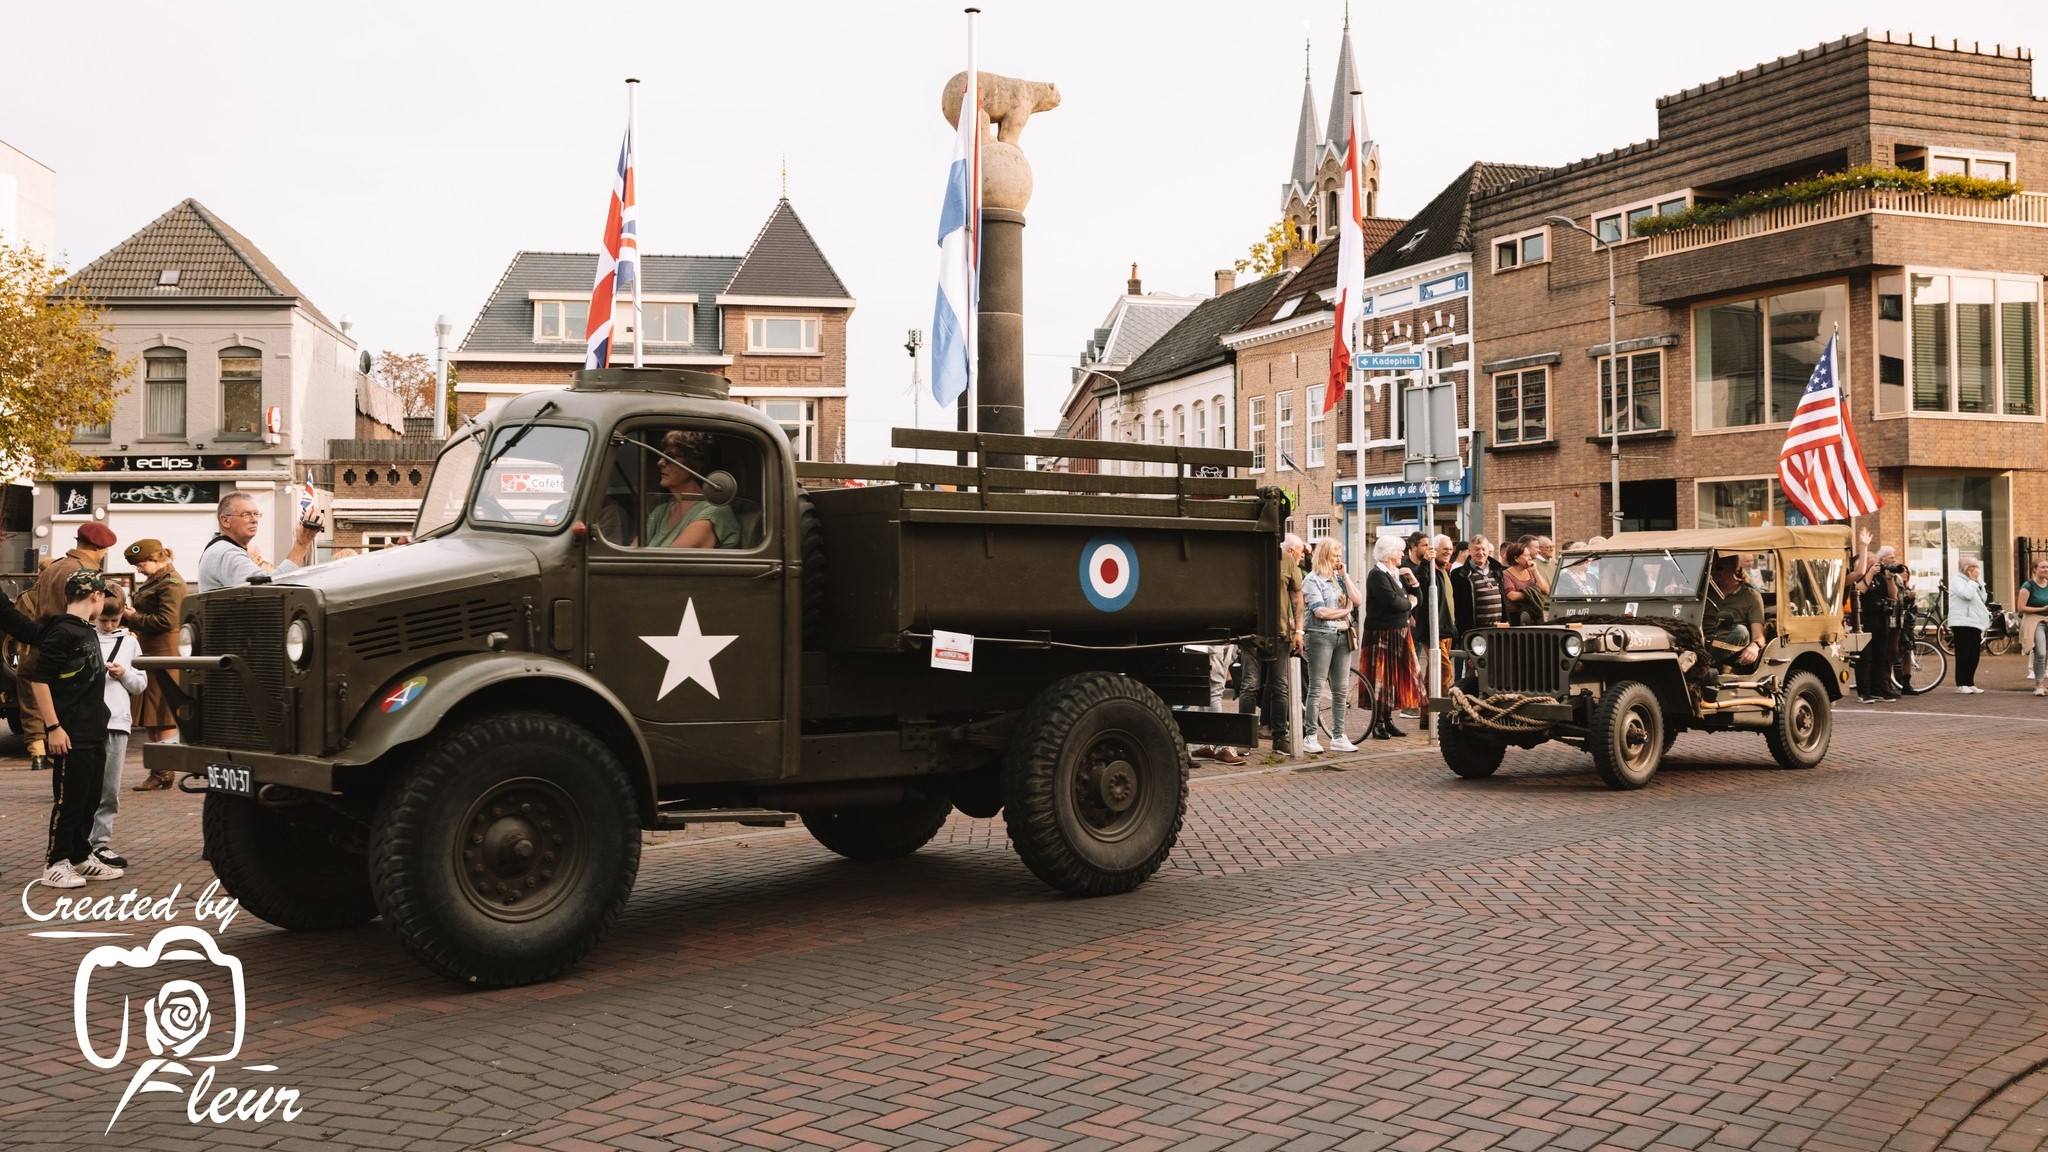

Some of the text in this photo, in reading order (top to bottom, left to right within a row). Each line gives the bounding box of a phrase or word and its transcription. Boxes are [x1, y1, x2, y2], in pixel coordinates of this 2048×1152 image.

[1372, 356, 1415, 366] Kadeplein
[136, 456, 193, 470] eclips
[1373, 485, 1395, 497] bakker
[1397, 485, 1406, 497] op
[1408, 482, 1417, 494] de
[207, 765, 250, 793] BE-90-37
